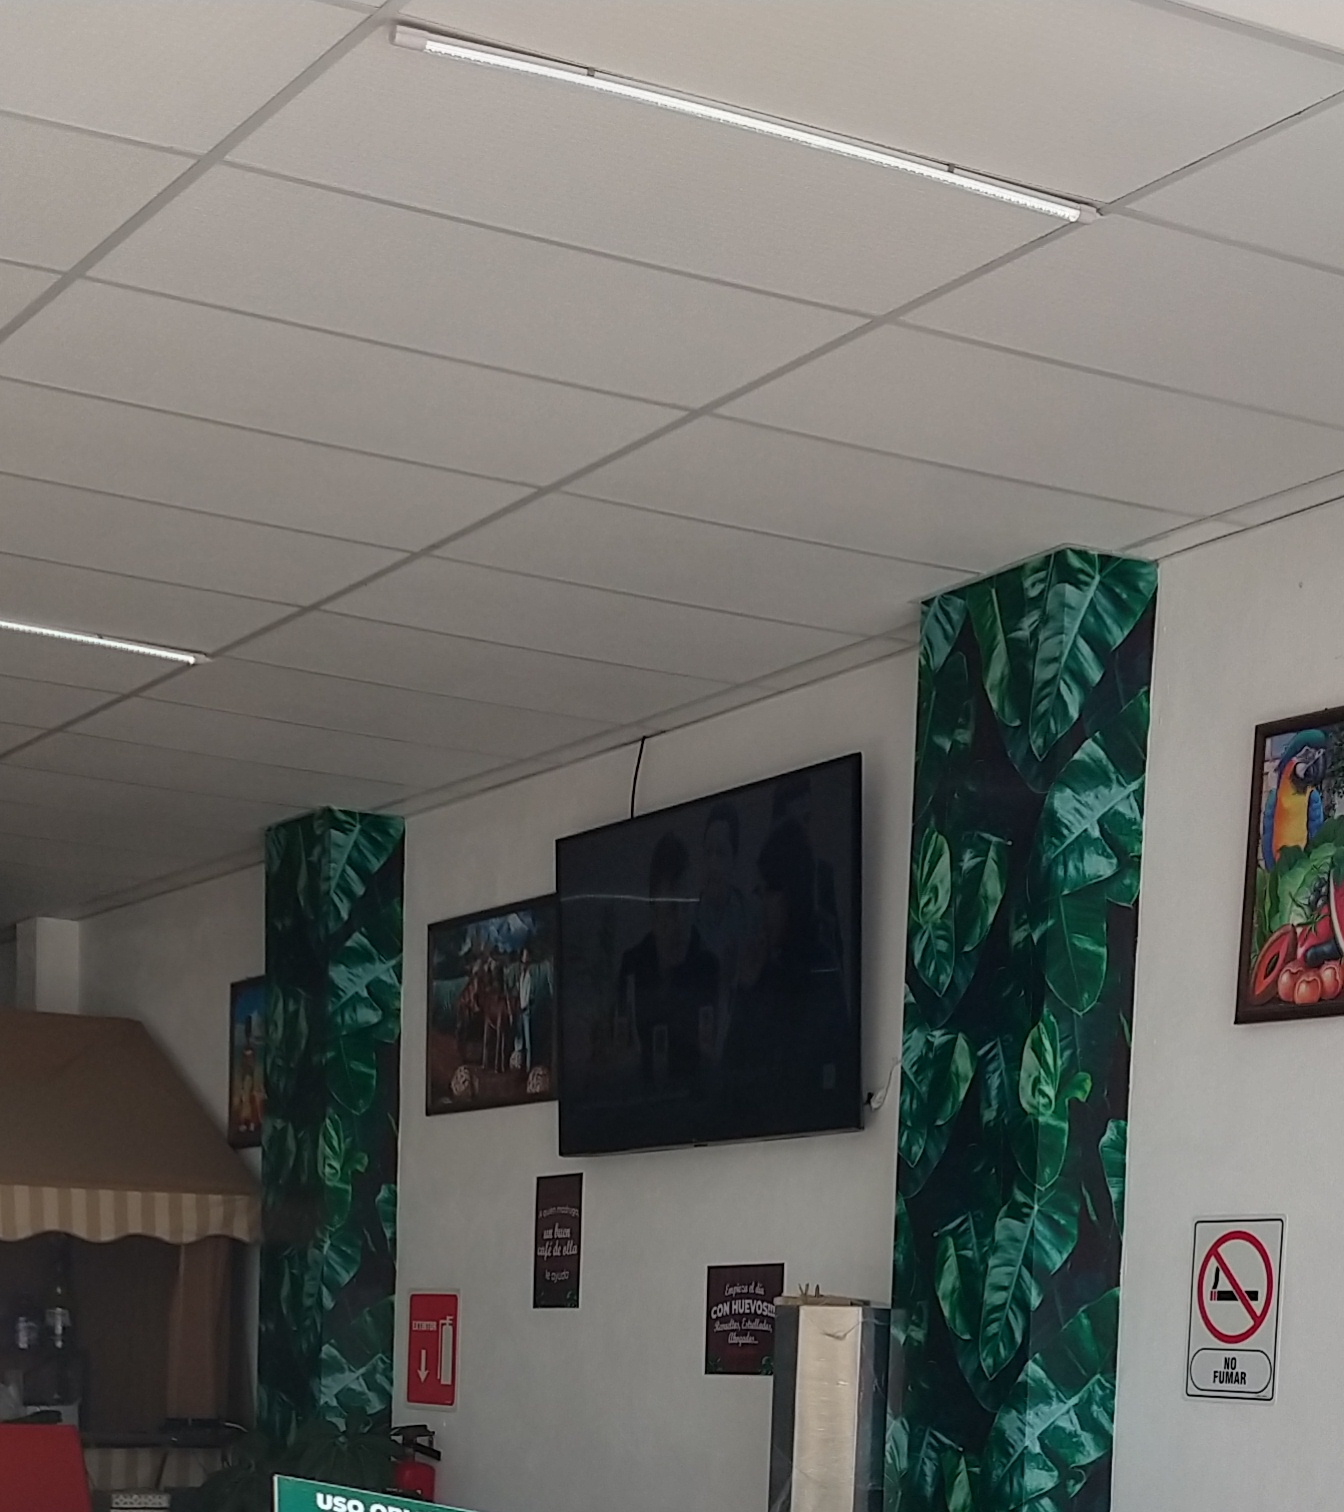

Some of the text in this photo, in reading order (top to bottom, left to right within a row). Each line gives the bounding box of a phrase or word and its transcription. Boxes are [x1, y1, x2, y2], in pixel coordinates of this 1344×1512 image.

[543, 1222, 571, 1239] un buen
[537, 1240, 578, 1261] café de olla
[545, 1269, 570, 1283] le ayuda
[749, 1281, 755, 1295] el
[711, 1301, 730, 1319] CON
[1223, 1357, 1237, 1370] NO
[1213, 1370, 1247, 1385] FUMAR
